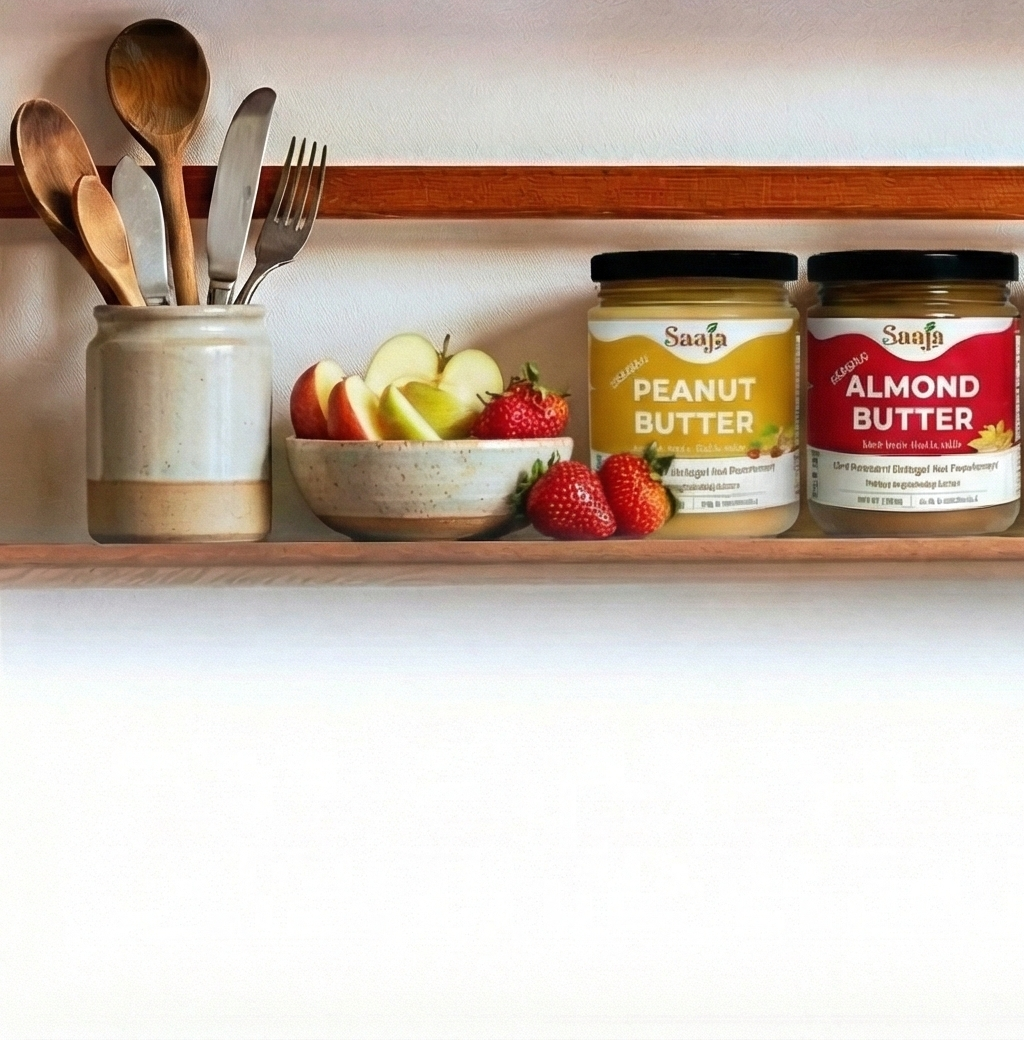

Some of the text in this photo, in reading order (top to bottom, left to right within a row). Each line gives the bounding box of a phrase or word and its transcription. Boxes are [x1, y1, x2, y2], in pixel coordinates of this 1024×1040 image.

[633, 377, 756, 402] PEANUT
[845, 374, 980, 399] ALMOND
[635, 411, 754, 435] BUTTER
[853, 406, 974, 431] BUTTER
